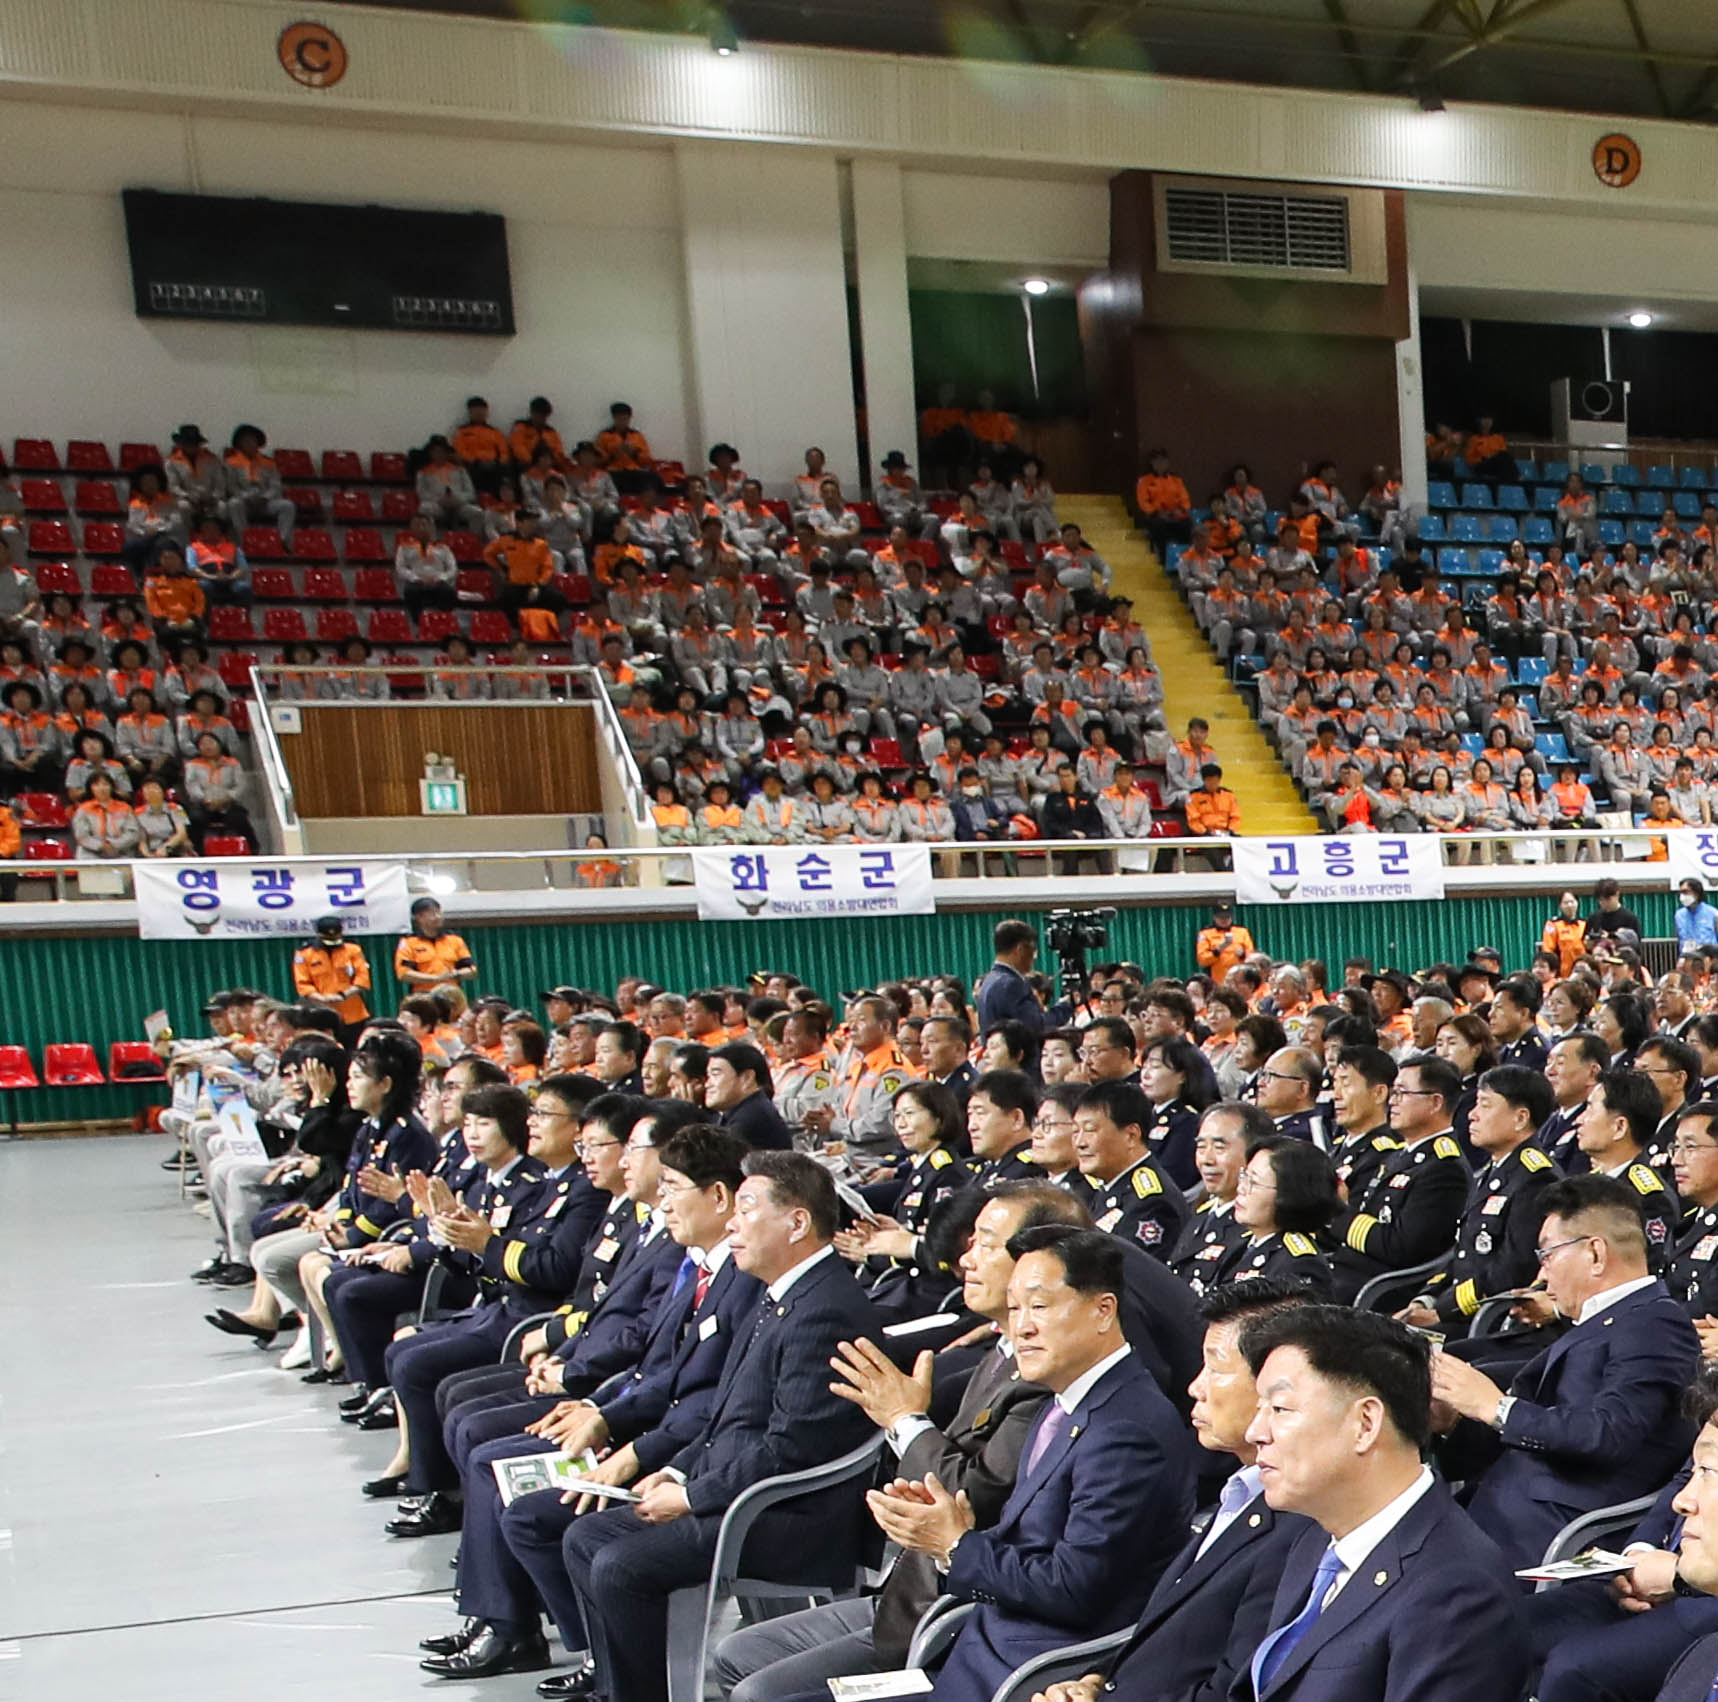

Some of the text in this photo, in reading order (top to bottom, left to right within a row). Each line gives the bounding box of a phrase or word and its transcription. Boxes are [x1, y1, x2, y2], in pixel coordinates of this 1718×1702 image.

[295, 38, 332, 73] C
[1605, 147, 1630, 174] D
[730, 851, 896, 891] 화순군
[1266, 841, 1410, 877] 고흥군
[177, 868, 366, 910] 영광군
